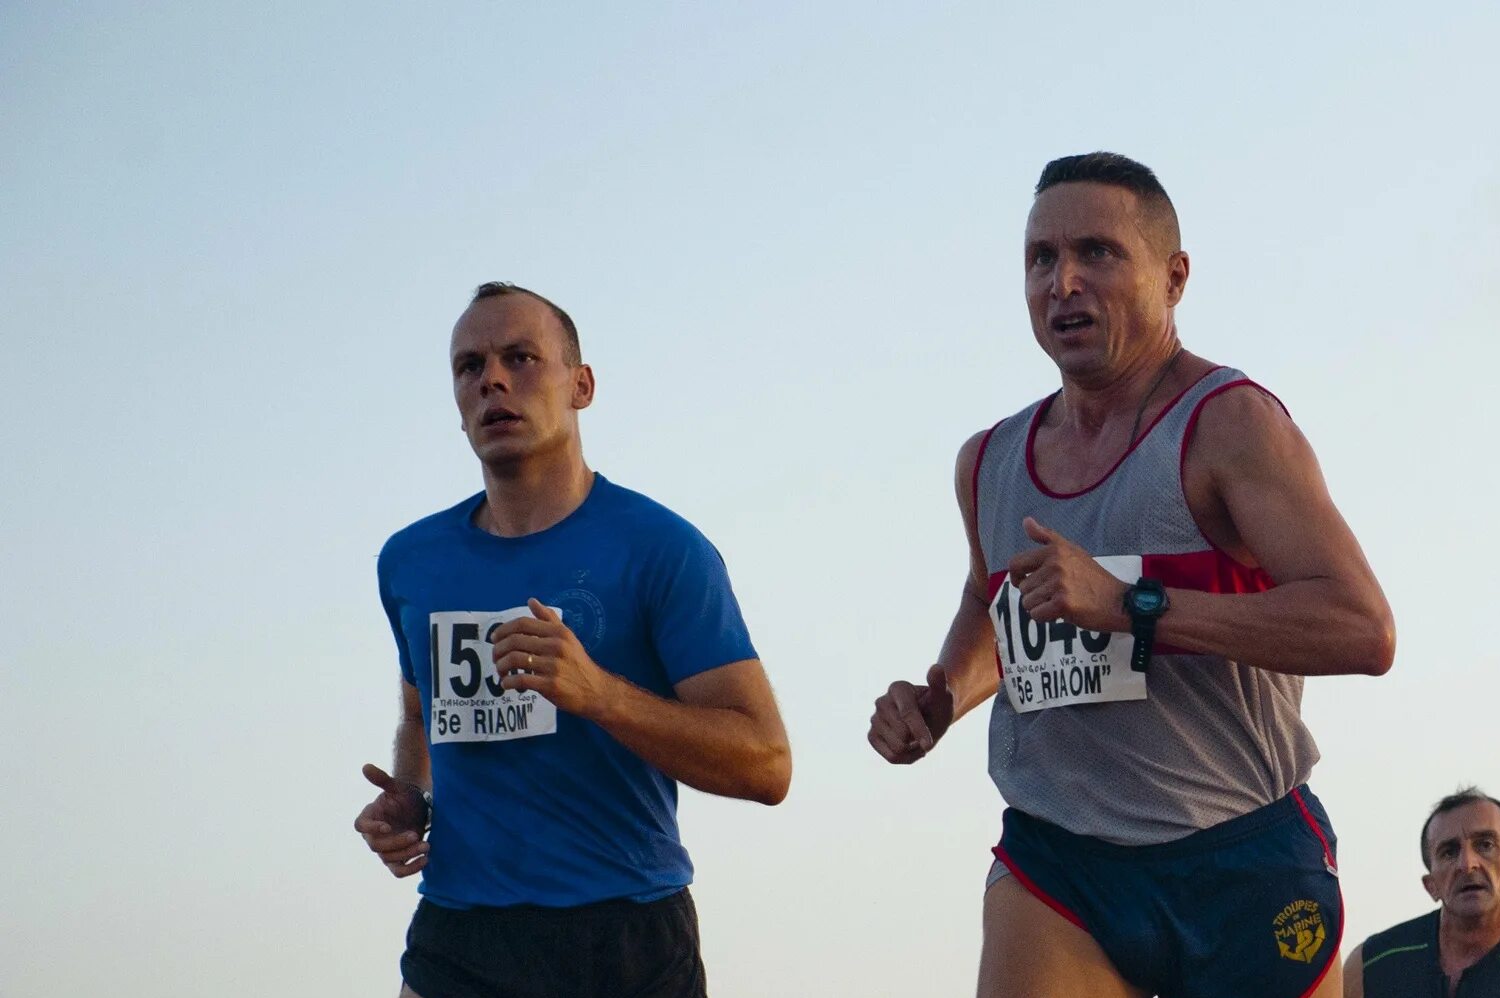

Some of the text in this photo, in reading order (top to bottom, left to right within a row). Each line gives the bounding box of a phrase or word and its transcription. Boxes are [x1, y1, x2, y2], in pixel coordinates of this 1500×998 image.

[1041, 665, 1111, 699] RIAOM"
[474, 703, 533, 734] RIAOM"
[1273, 899, 1319, 926] TROUPES
